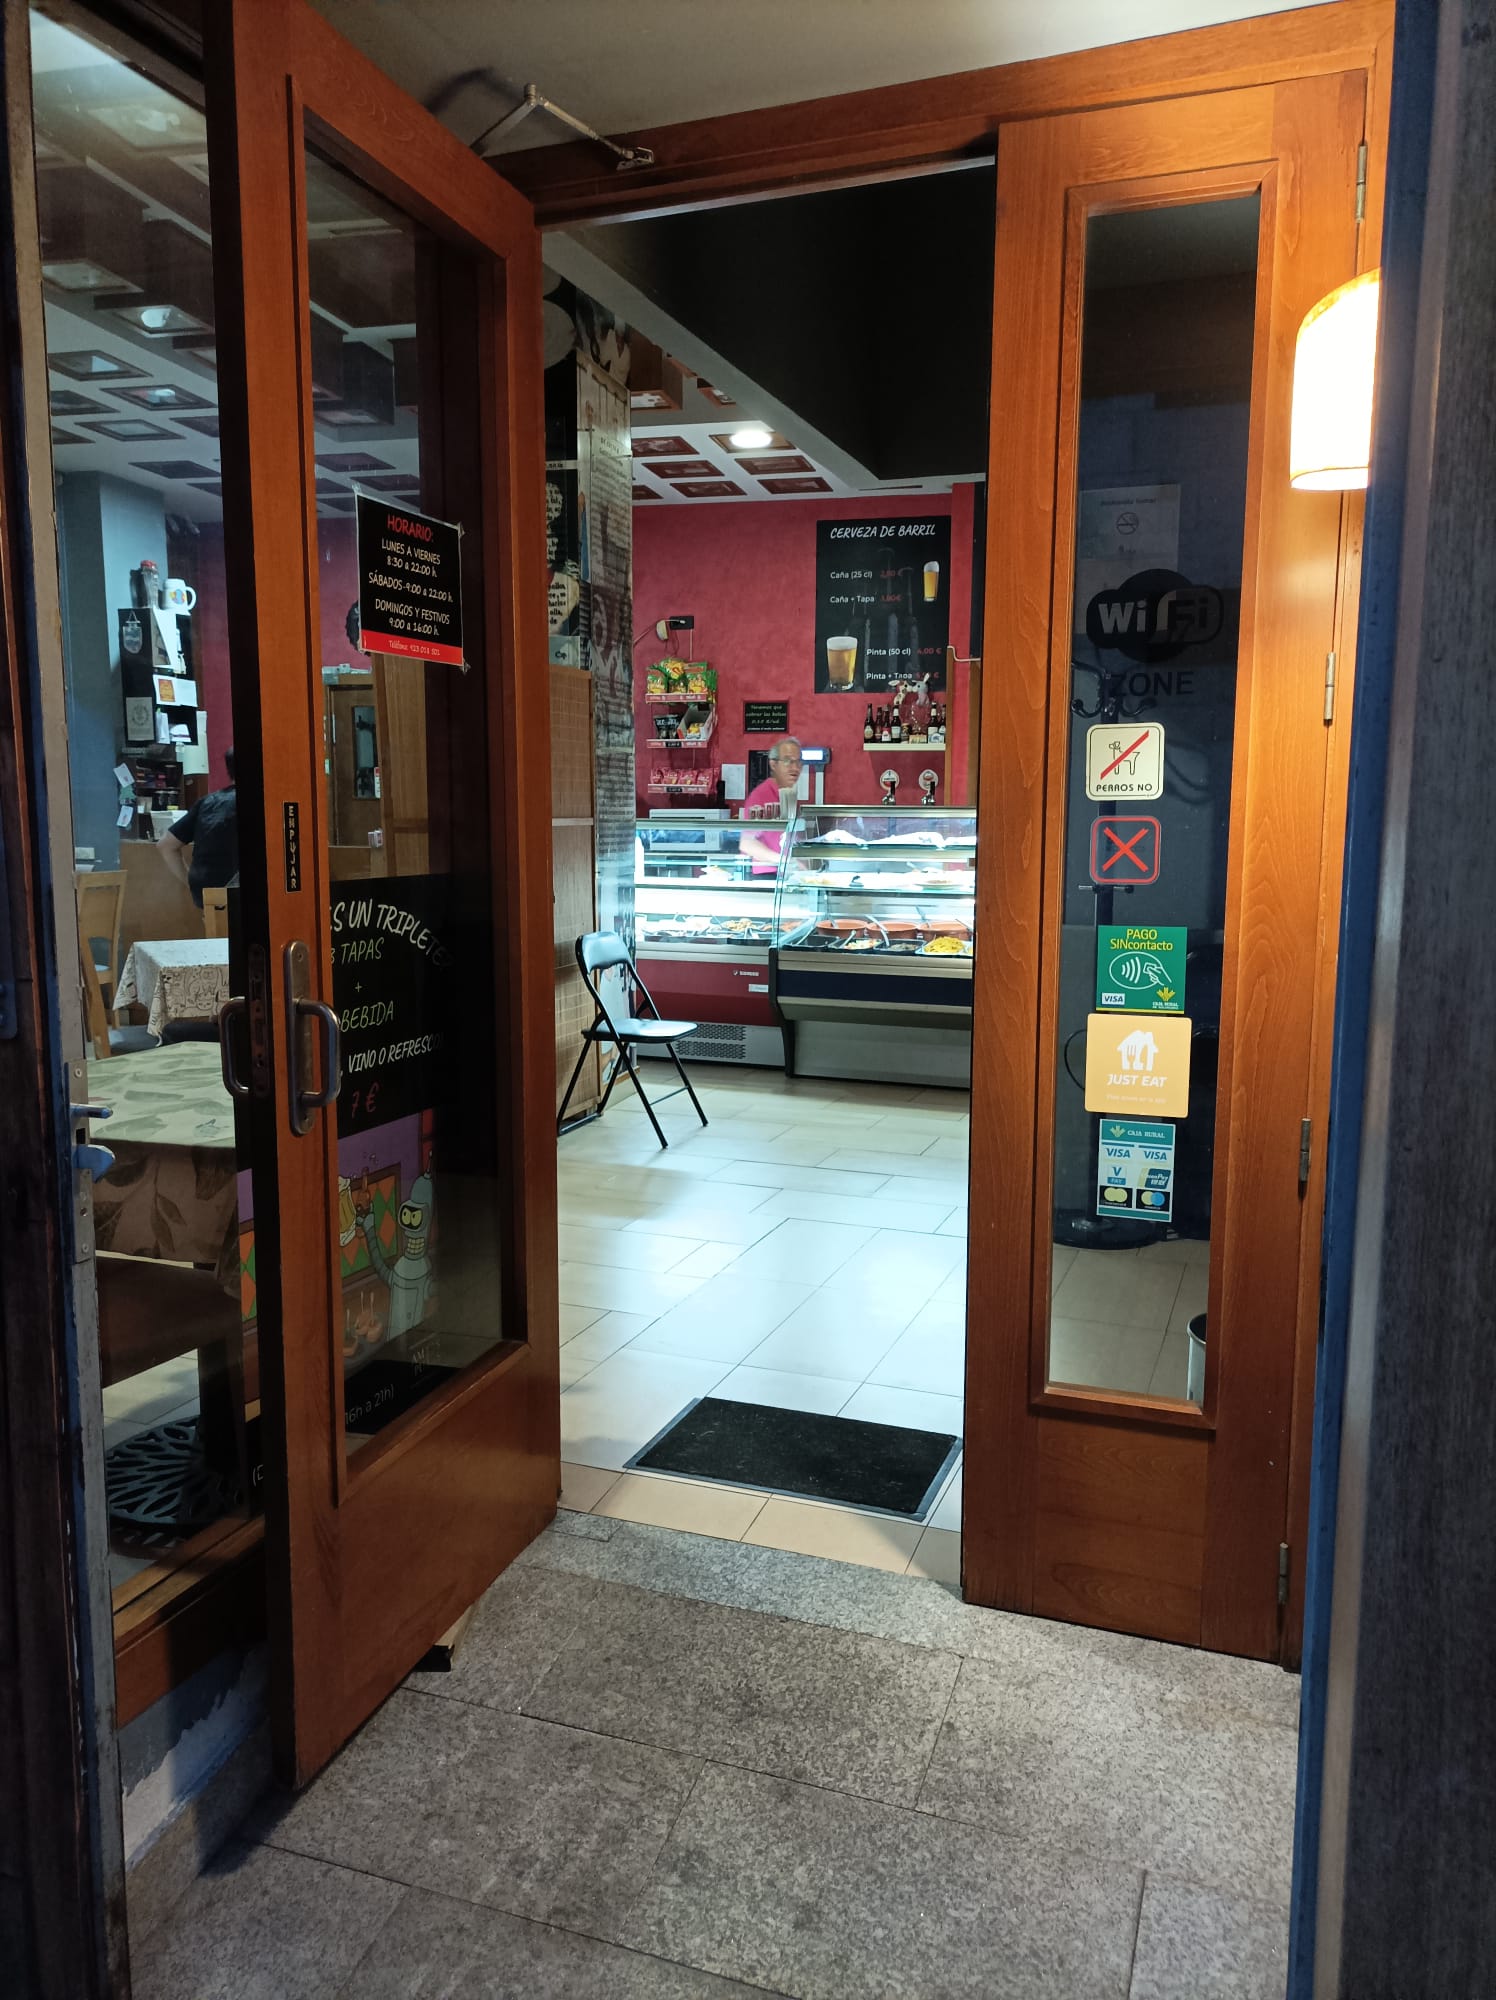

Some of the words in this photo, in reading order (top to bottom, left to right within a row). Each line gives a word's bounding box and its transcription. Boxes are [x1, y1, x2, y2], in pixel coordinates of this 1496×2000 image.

[830, 526, 878, 539] CERVEZA
[879, 525, 896, 538] DE
[898, 524, 936, 537] BARRIL
[382, 538, 405, 555] LUNES
[406, 546, 413, 557] A
[414, 547, 441, 565] VIERNES
[387, 555, 403, 568] 8:30
[404, 562, 410, 570] a
[411, 562, 431, 576] 22:00
[830, 571, 849, 579] Caña
[851, 571, 862, 580] (25
[863, 570, 873, 579] cl)
[422, 587, 428, 596] a
[429, 588, 448, 600] 22:00
[830, 595, 849, 603] Caña
[857, 595, 875, 603] Tapa
[376, 598, 413, 617] DOMINGOS
[415, 607, 421, 617] Y
[422, 609, 450, 625] FESTIVOS
[389, 617, 405, 629] 9:00
[407, 622, 412, 630] a
[413, 622, 432, 635] 16:00
[867, 648, 886, 656] Pinta
[888, 648, 900, 657] (50
[902, 648, 911, 657] cl)
[866, 672, 886, 680] Pinta
[1109, 671, 1195, 697] ZONE
[1096, 784, 1134, 792] PERROS
[1137, 784, 1152, 792] NO
[288, 805, 297, 889] EMPUJAR
[348, 897, 373, 929] UN
[1127, 928, 1158, 941] PAGO
[341, 936, 385, 965] TAPAS
[1110, 938, 1173, 951] SINcontacto
[341, 1000, 395, 1033] BEBIDA
[348, 1048, 377, 1074] VINO
[378, 1047, 387, 1066] O
[1107, 1074, 1137, 1087] JUST
[1141, 1076, 1167, 1089] EAT
[367, 1080, 381, 1113] €
[1106, 1147, 1131, 1158] VISA
[1143, 1150, 1167, 1161] VISA
[1112, 1166, 1122, 1177] V
